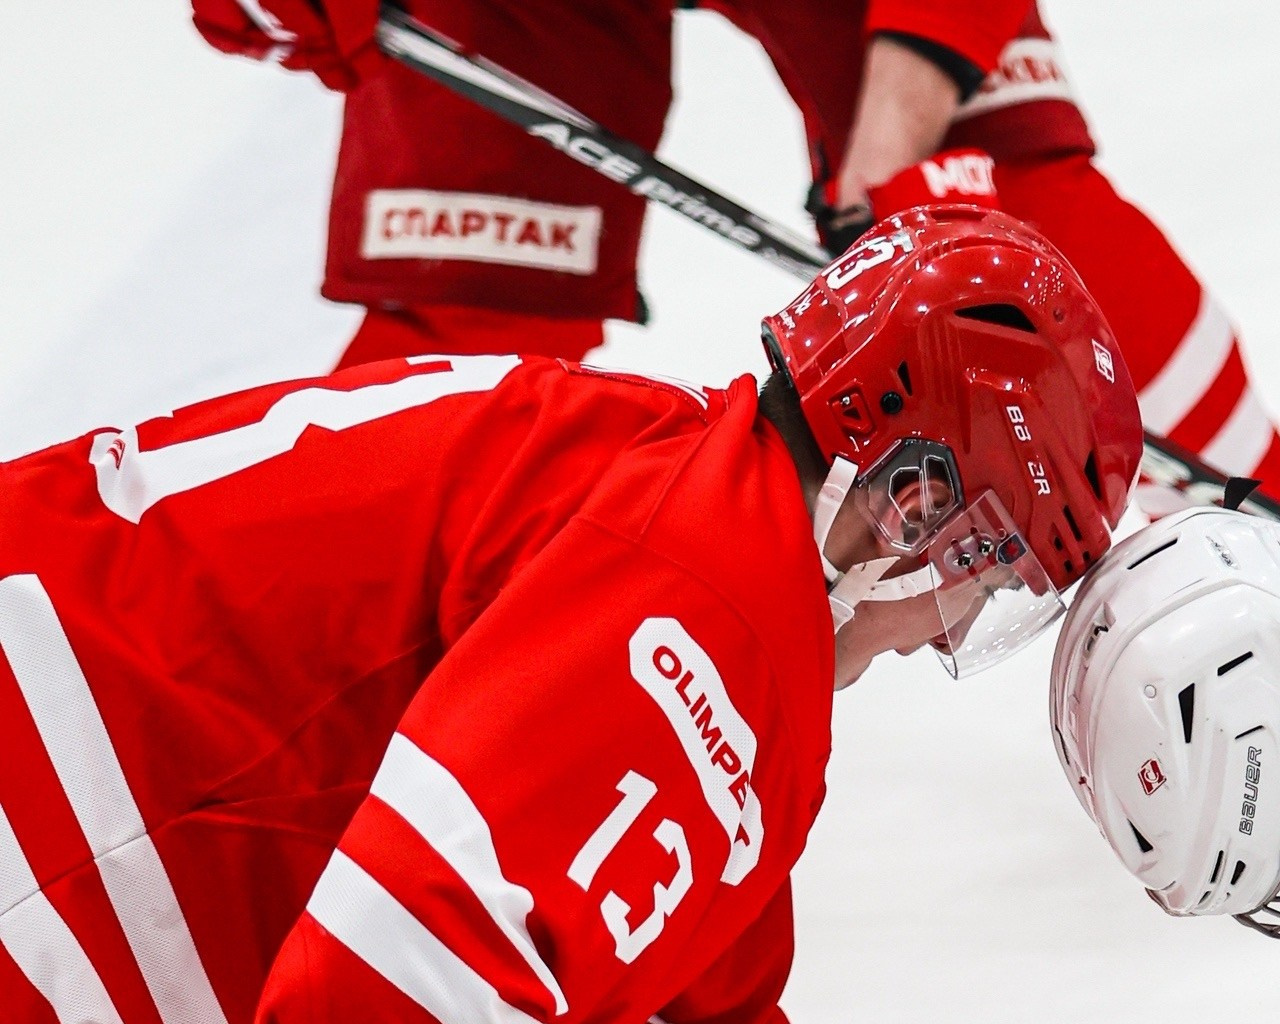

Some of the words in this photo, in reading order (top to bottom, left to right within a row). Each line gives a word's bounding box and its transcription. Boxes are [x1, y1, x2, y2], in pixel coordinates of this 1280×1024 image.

[528, 122, 643, 183] ACE
[383, 208, 577, 254] СПАРТАК
[566, 769, 693, 965] 13
